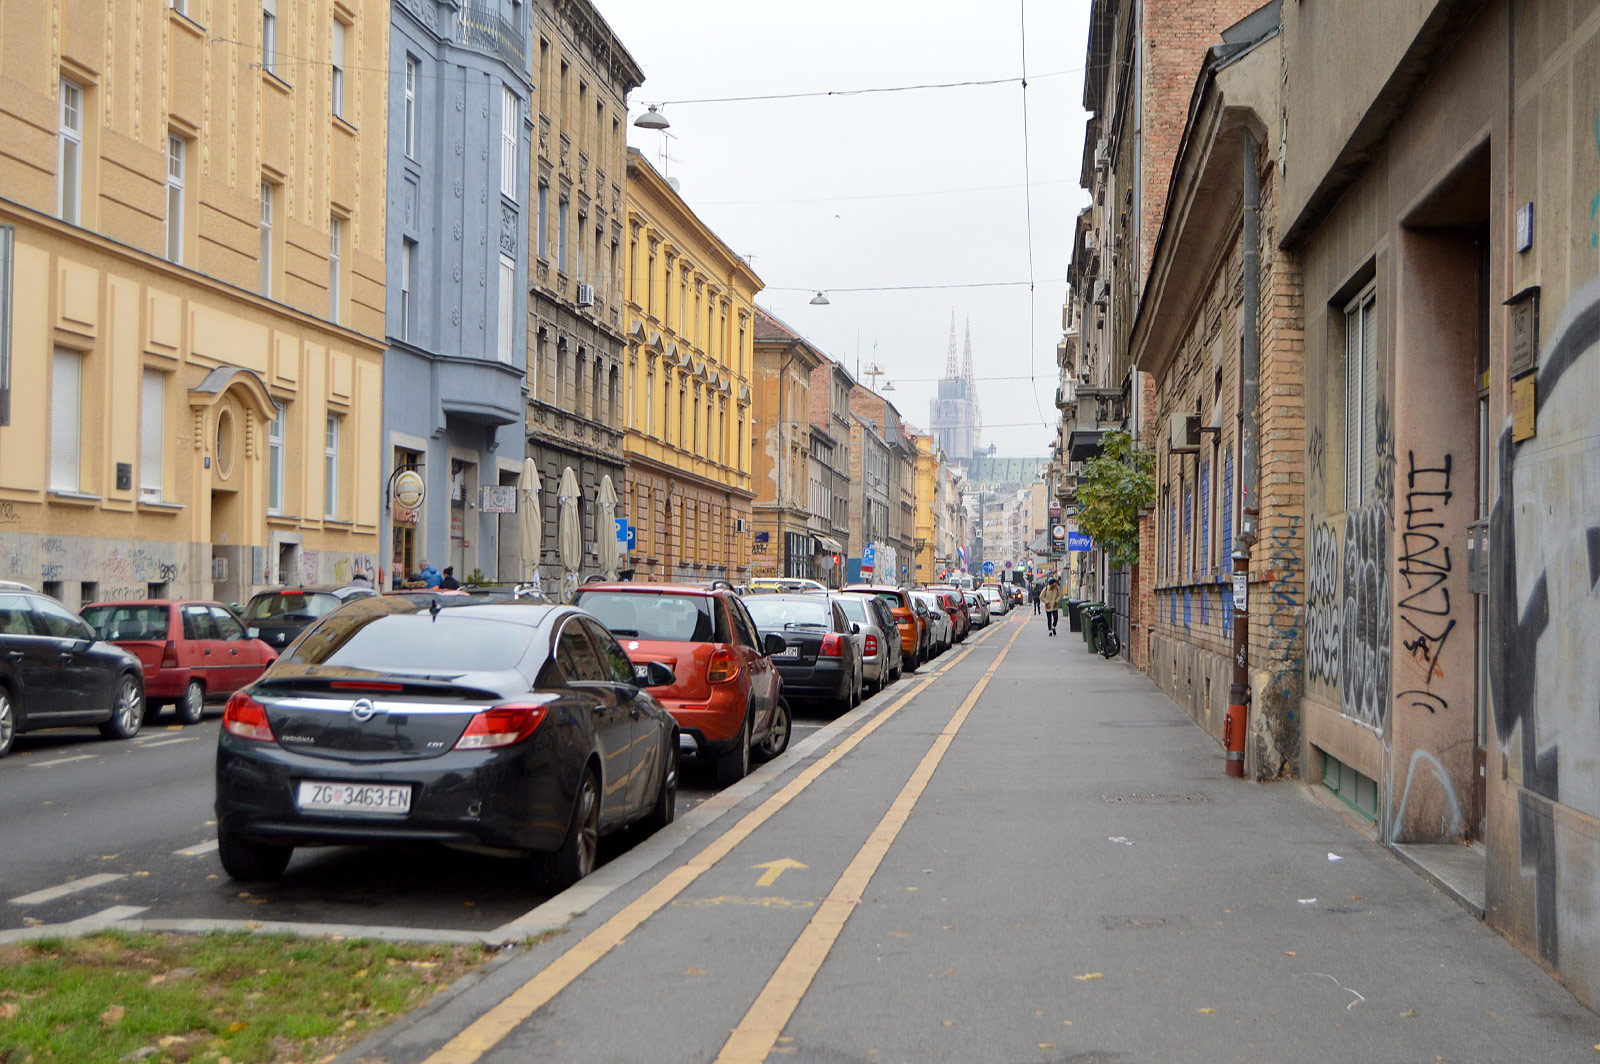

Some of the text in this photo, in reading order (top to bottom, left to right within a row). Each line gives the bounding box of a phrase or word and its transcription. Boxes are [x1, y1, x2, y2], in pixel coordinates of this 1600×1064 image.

[1069, 538, 1091, 547] Thrifty
[281, 734, 315, 744] INSIGNIA
[312, 785, 332, 803] ZG
